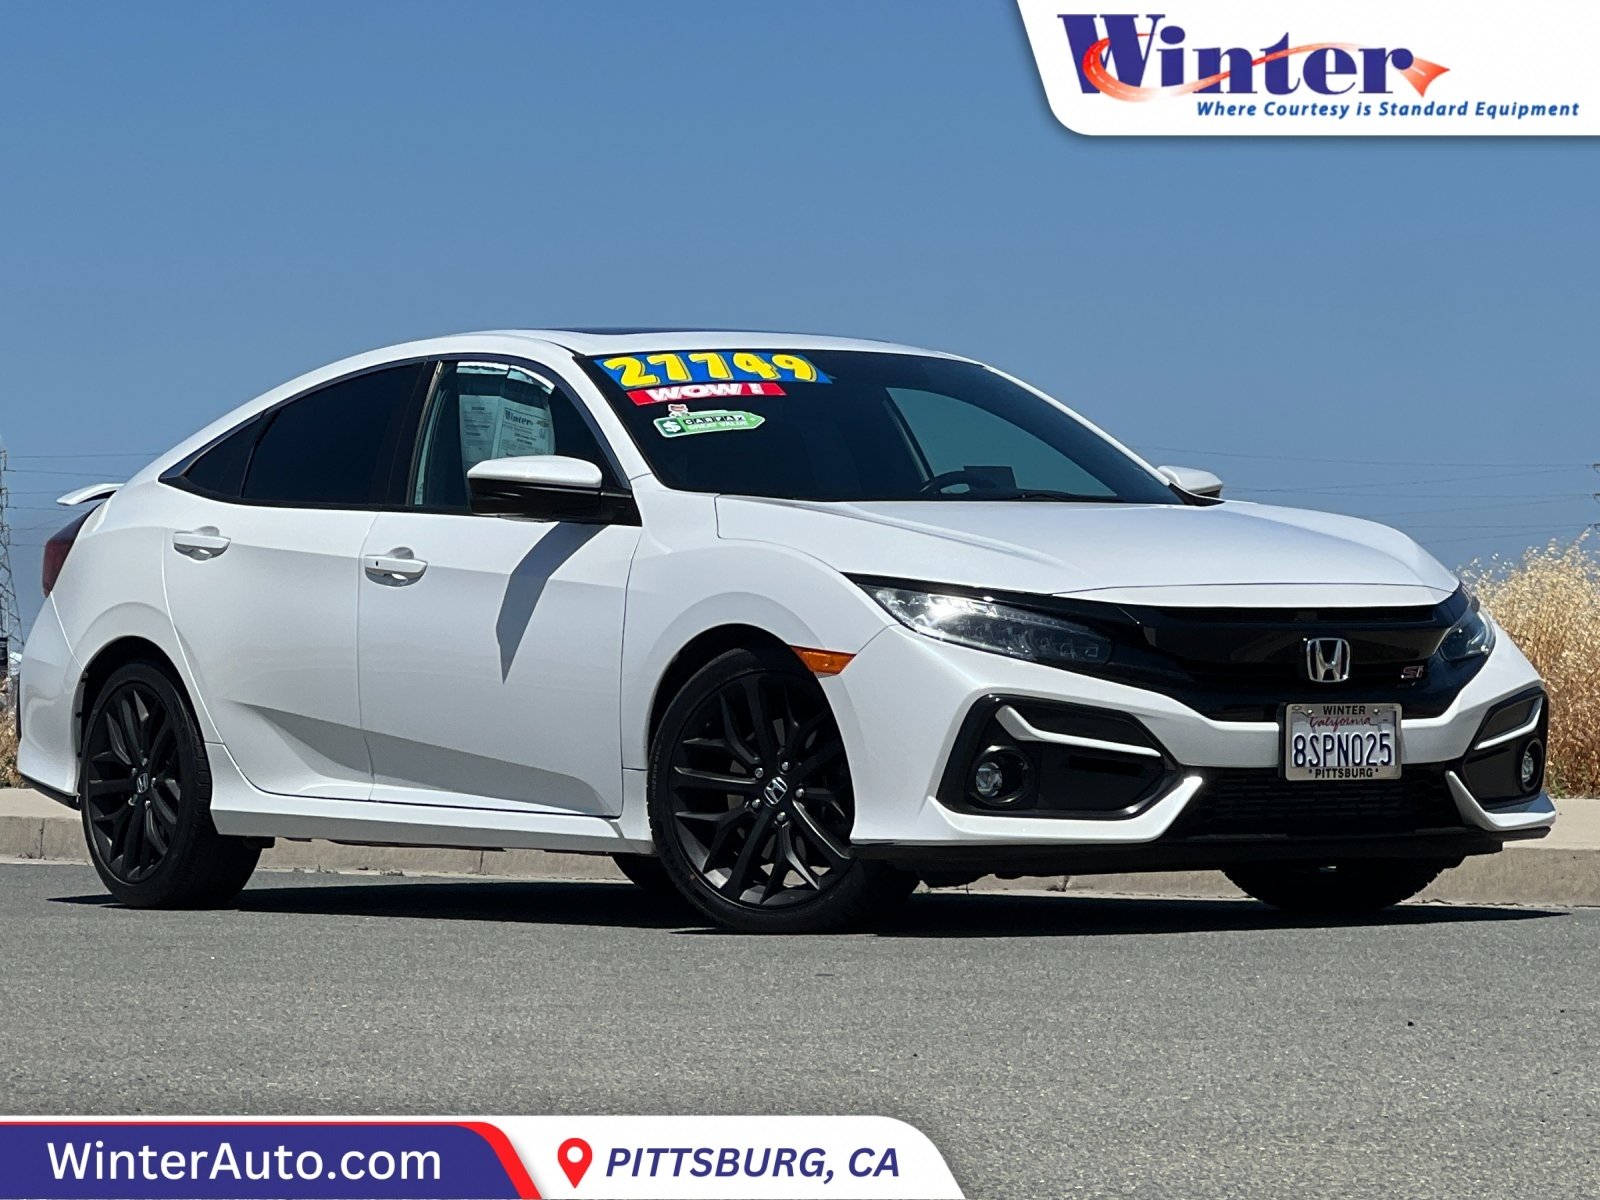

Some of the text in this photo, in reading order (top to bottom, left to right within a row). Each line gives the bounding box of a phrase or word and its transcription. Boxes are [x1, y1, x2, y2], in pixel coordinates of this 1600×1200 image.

[602, 352, 818, 389] 27749
[684, 415, 745, 425] CARFAX
[1323, 705, 1367, 716] WINTER
[1309, 715, 1373, 732] California
[1293, 732, 1392, 768] 8SPN025
[1315, 767, 1374, 779] PITTSBURG
